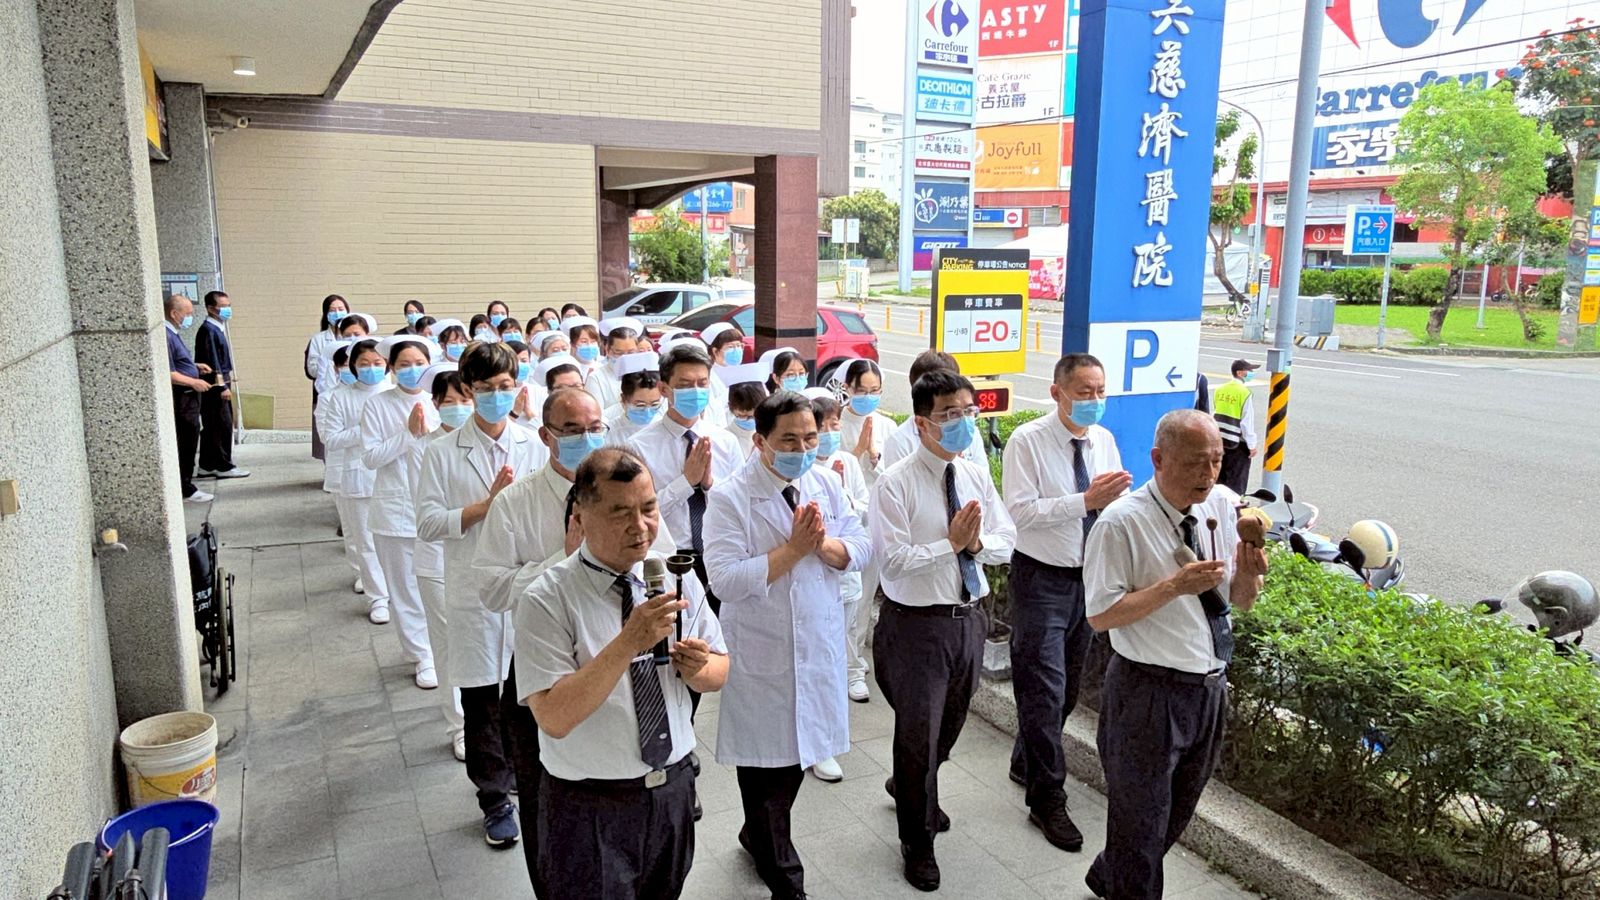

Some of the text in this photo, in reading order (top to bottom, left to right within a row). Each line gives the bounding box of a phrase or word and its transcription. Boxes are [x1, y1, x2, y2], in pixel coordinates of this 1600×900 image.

[981, 4, 1047, 28] ASTY
[924, 38, 969, 53] Carrefour
[1048, 40, 1059, 48] 1F
[919, 80, 971, 96] DECATHLON
[981, 93, 1026, 110] 古拉爵
[1043, 107, 1055, 116] 1F
[987, 140, 1042, 160] Joyfull
[1358, 215, 1371, 236] P
[964, 298, 1004, 308] 停車費率
[947, 320, 1019, 342] 一小時 20 元
[1122, 329, 1160, 392] P
